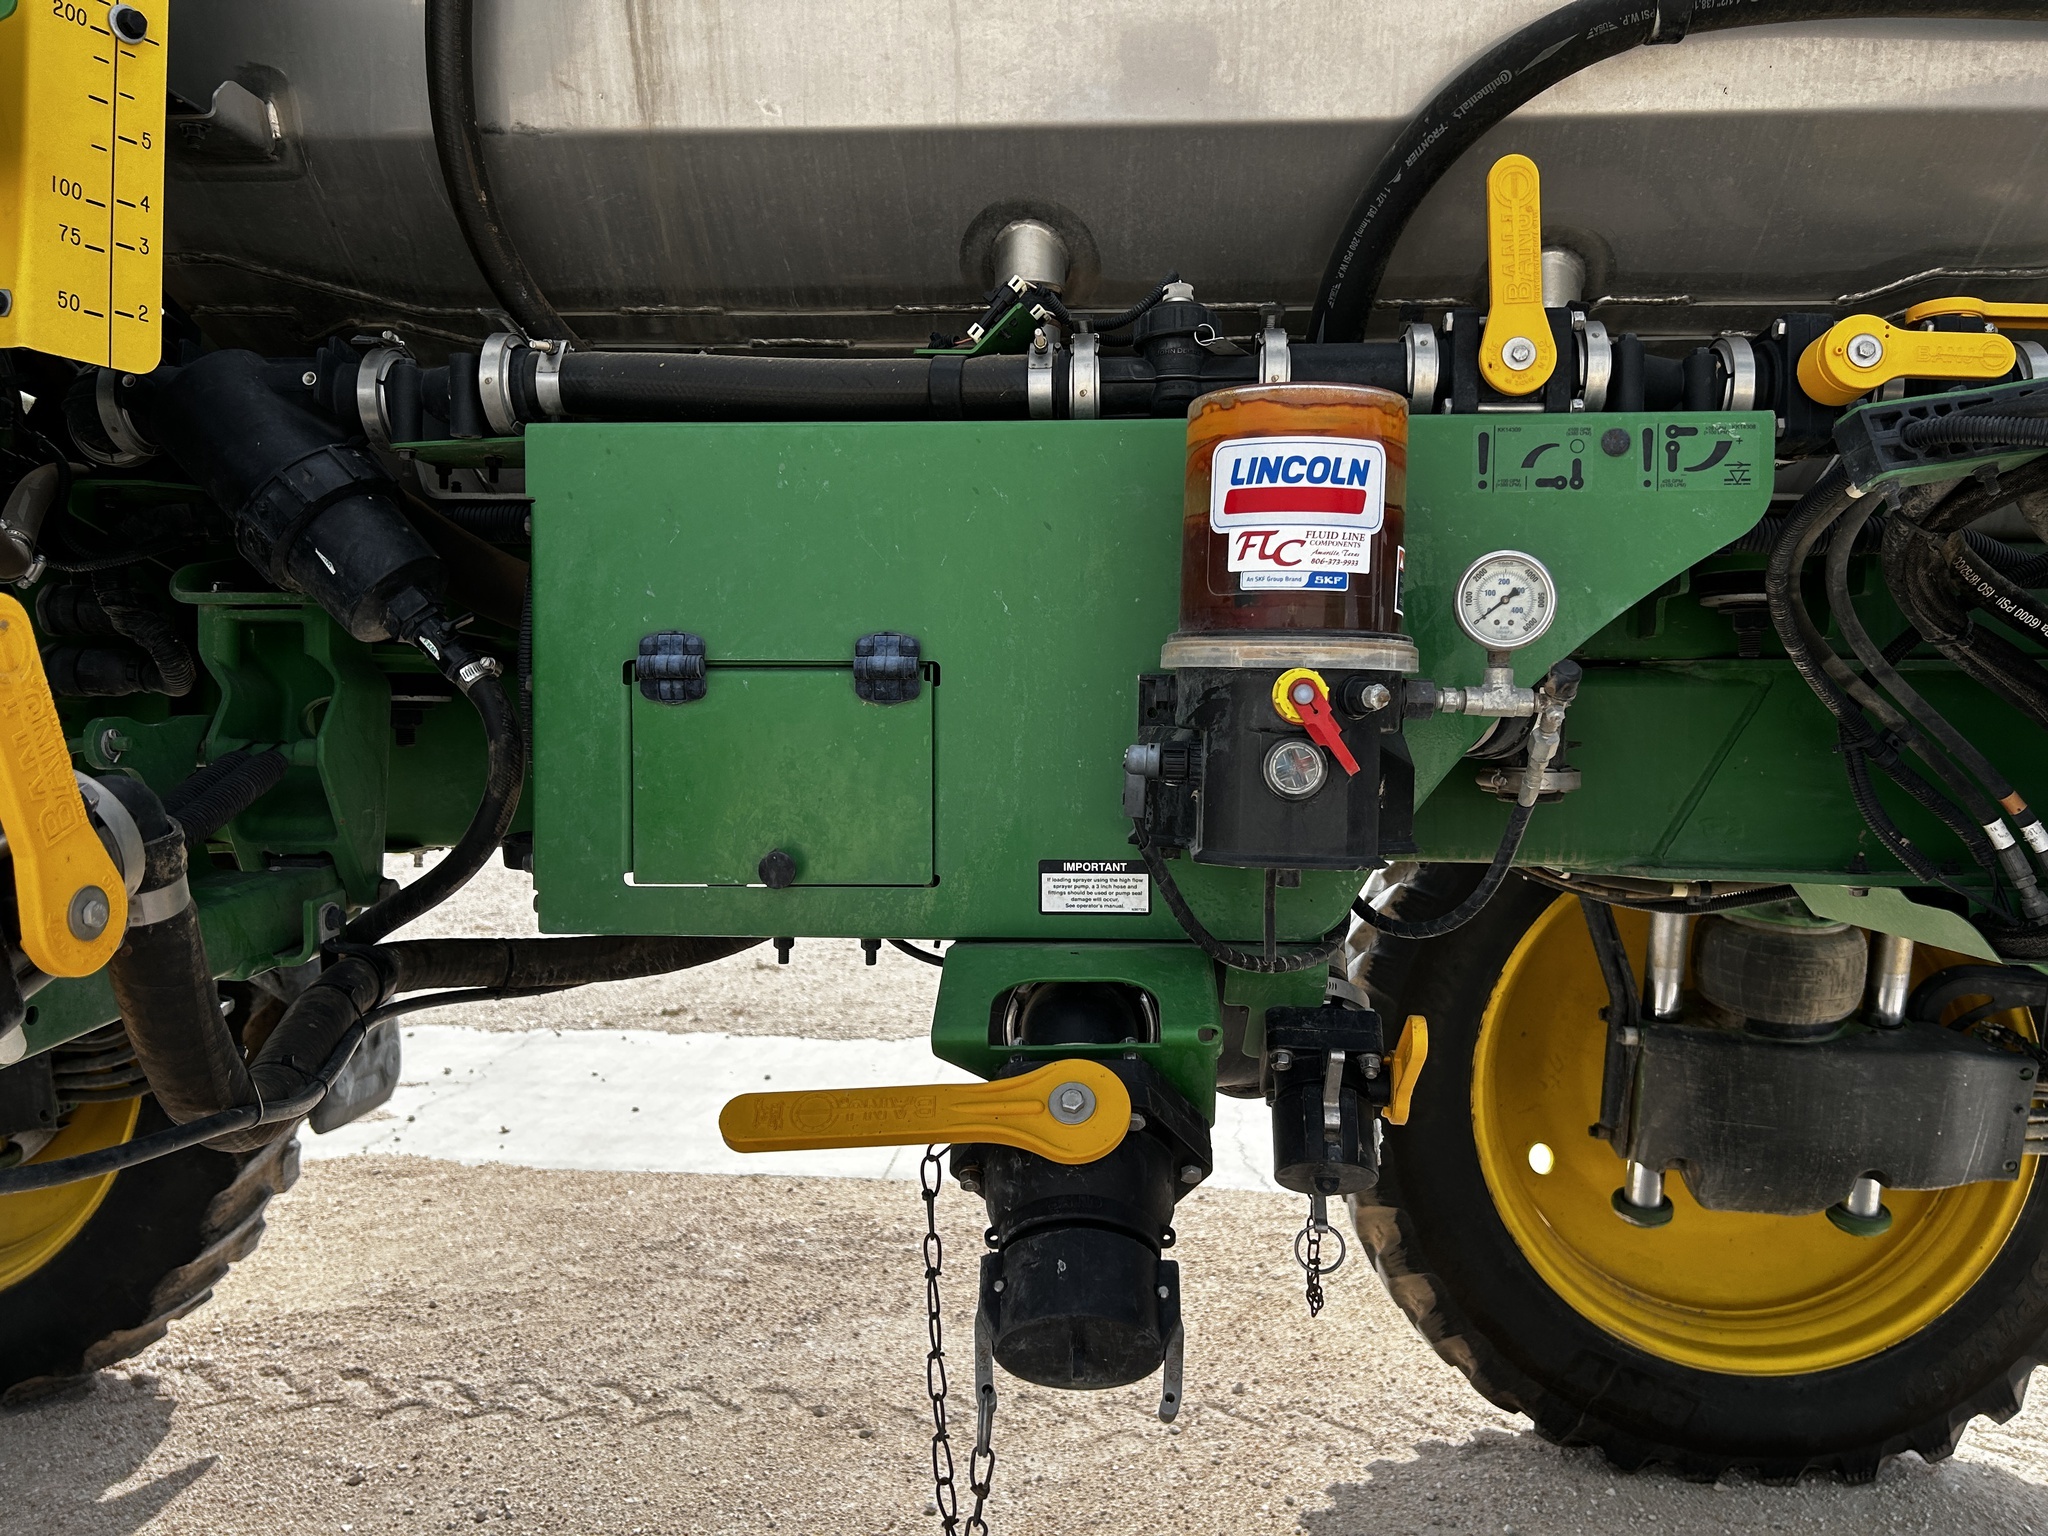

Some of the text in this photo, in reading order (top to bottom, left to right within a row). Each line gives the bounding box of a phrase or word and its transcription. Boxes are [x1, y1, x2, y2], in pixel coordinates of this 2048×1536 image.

[53, 0, 87, 27] 200
[1459, 69, 1513, 116] Continental
[141, 132, 152, 150] 5
[1404, 123, 1448, 168] FRONTIER
[52, 175, 82, 200] 100
[140, 195, 151, 213] 4
[58, 223, 81, 246] 75
[139, 238, 150, 255] 3
[1348, 236, 1360, 251] 200
[1342, 250, 1354, 264] PSI
[57, 291, 80, 312] 50
[138, 305, 149, 322] 2
[1230, 456, 1371, 487] LINCOLN
[1305, 530, 1366, 541] FLUID LINE
[1235, 530, 1307, 566] FLC
[1309, 540, 1361, 548] COMPONENTS
[1342, 549, 1360, 557] Texas
[1310, 559, 1359, 567] 806-373-9933
[1314, 576, 1343, 584] SKF
[1473, 568, 1488, 582] 2000
[1524, 569, 1539, 582] 4000
[1977, 582, 1996, 598] ISO
[1465, 591, 1473, 606] 1000
[1537, 592, 1545, 608] 5000
[1995, 596, 2017, 613] PSI)
[1522, 617, 1538, 631] 6000
[2013, 608, 2042, 629] (6000
[1063, 862, 1127, 872] IMPORTANT
